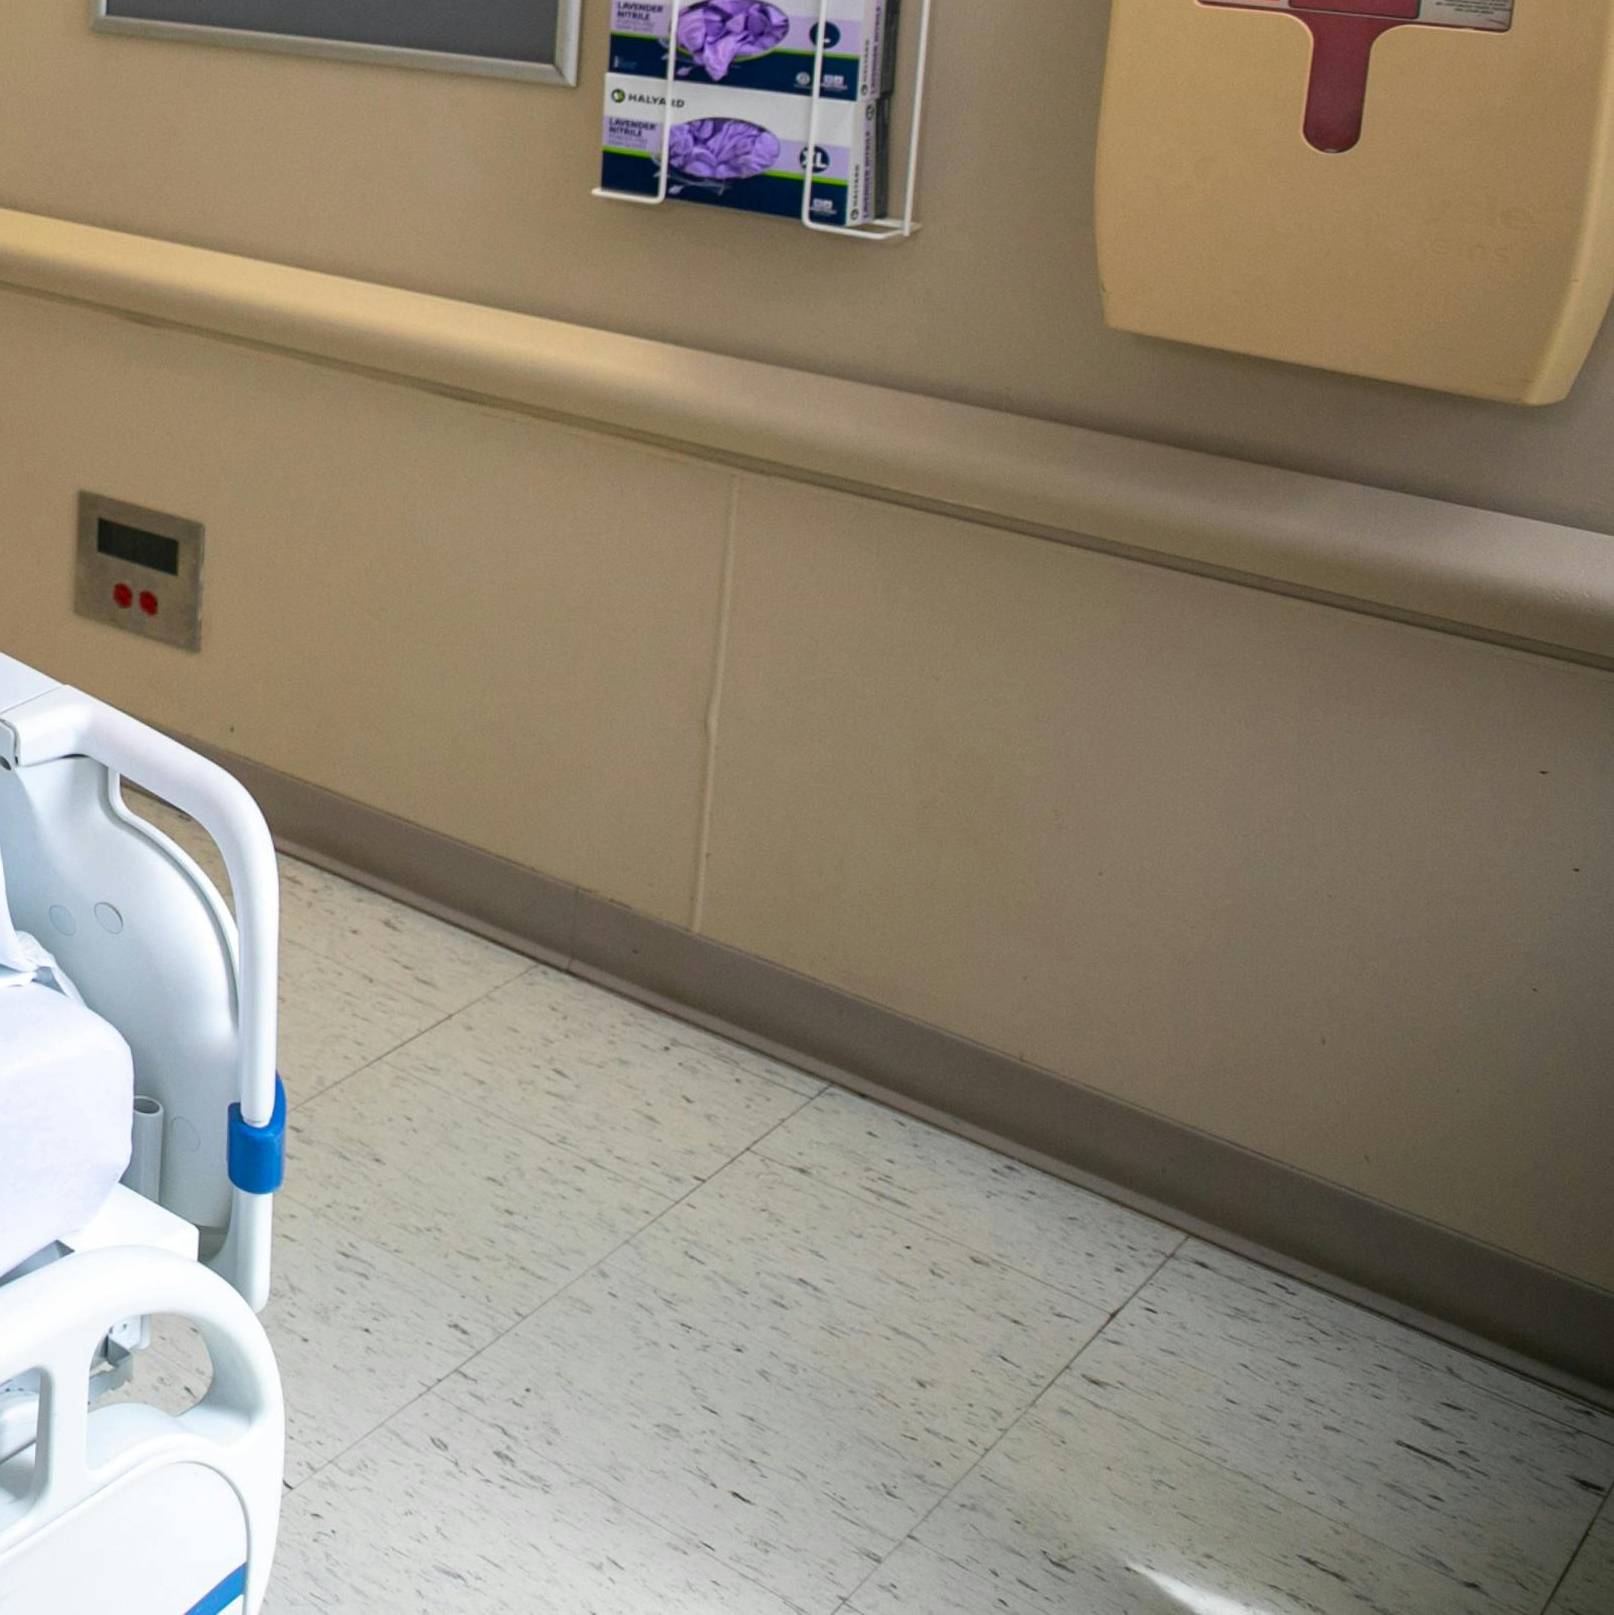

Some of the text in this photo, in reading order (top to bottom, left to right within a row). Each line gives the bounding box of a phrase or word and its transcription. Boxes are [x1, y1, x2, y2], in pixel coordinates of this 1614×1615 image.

[618, 1, 663, 13] LAVENDER
[617, 11, 650, 21] NITRILE
[609, 117, 657, 131] LAVENDER
[609, 126, 642, 137] NITRILE
